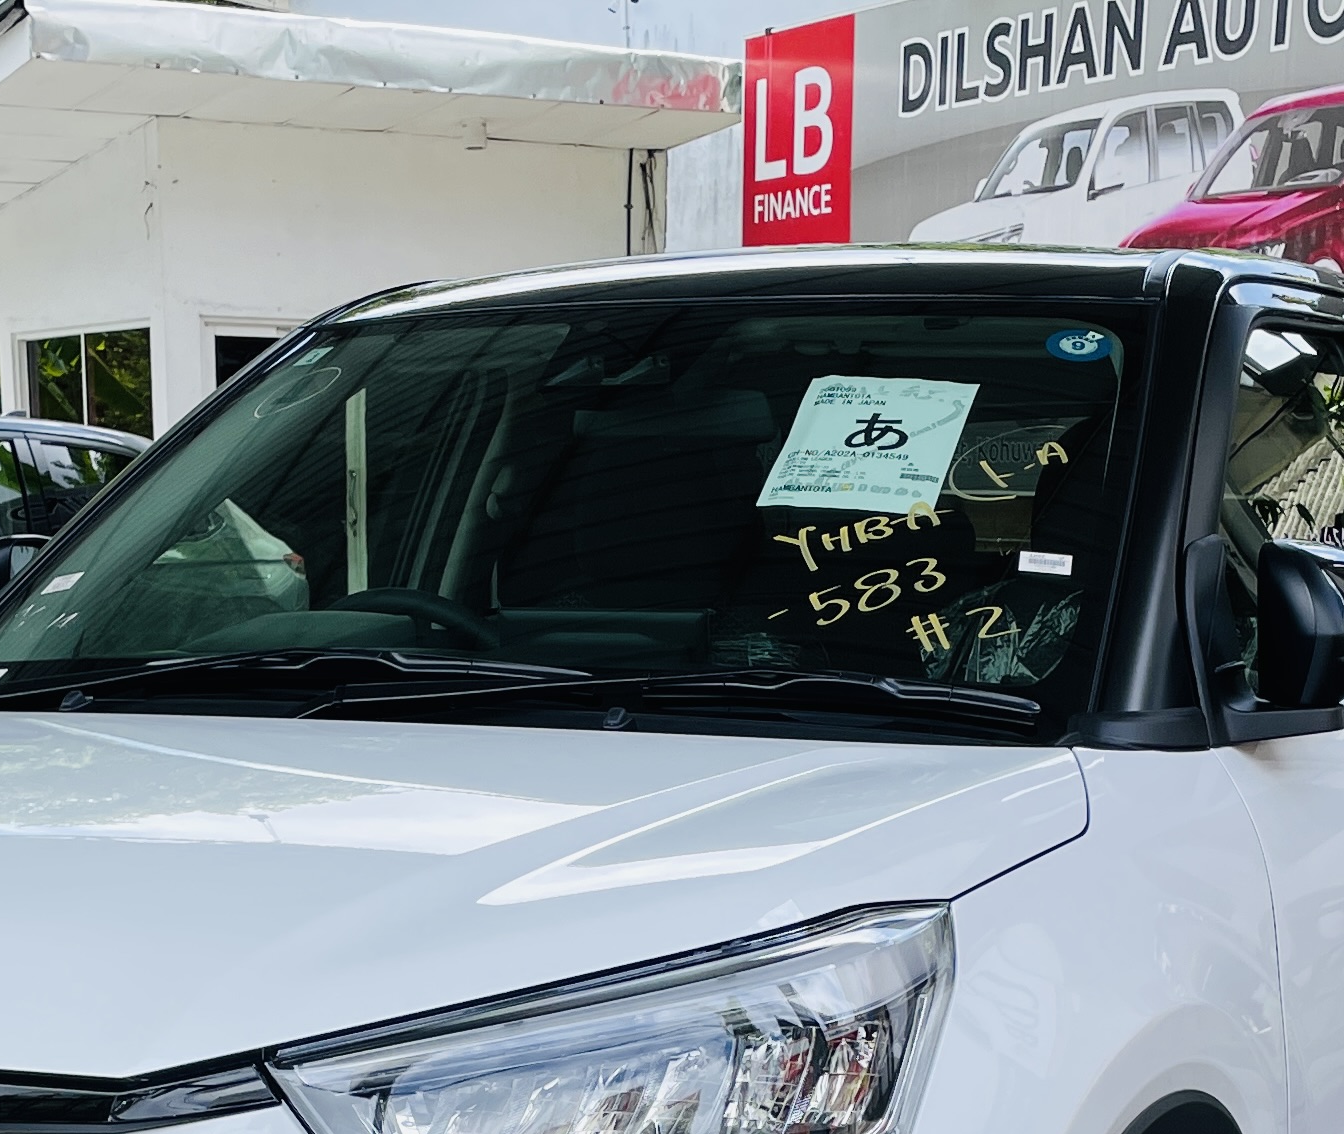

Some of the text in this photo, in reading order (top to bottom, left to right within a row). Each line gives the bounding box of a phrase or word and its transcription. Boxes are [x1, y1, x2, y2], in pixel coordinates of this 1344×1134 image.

[899, 0, 1148, 118] DILSHAN
[754, 65, 834, 182] LB
[754, 184, 832, 224] FINANCE
[844, 412, 908, 450] あ
